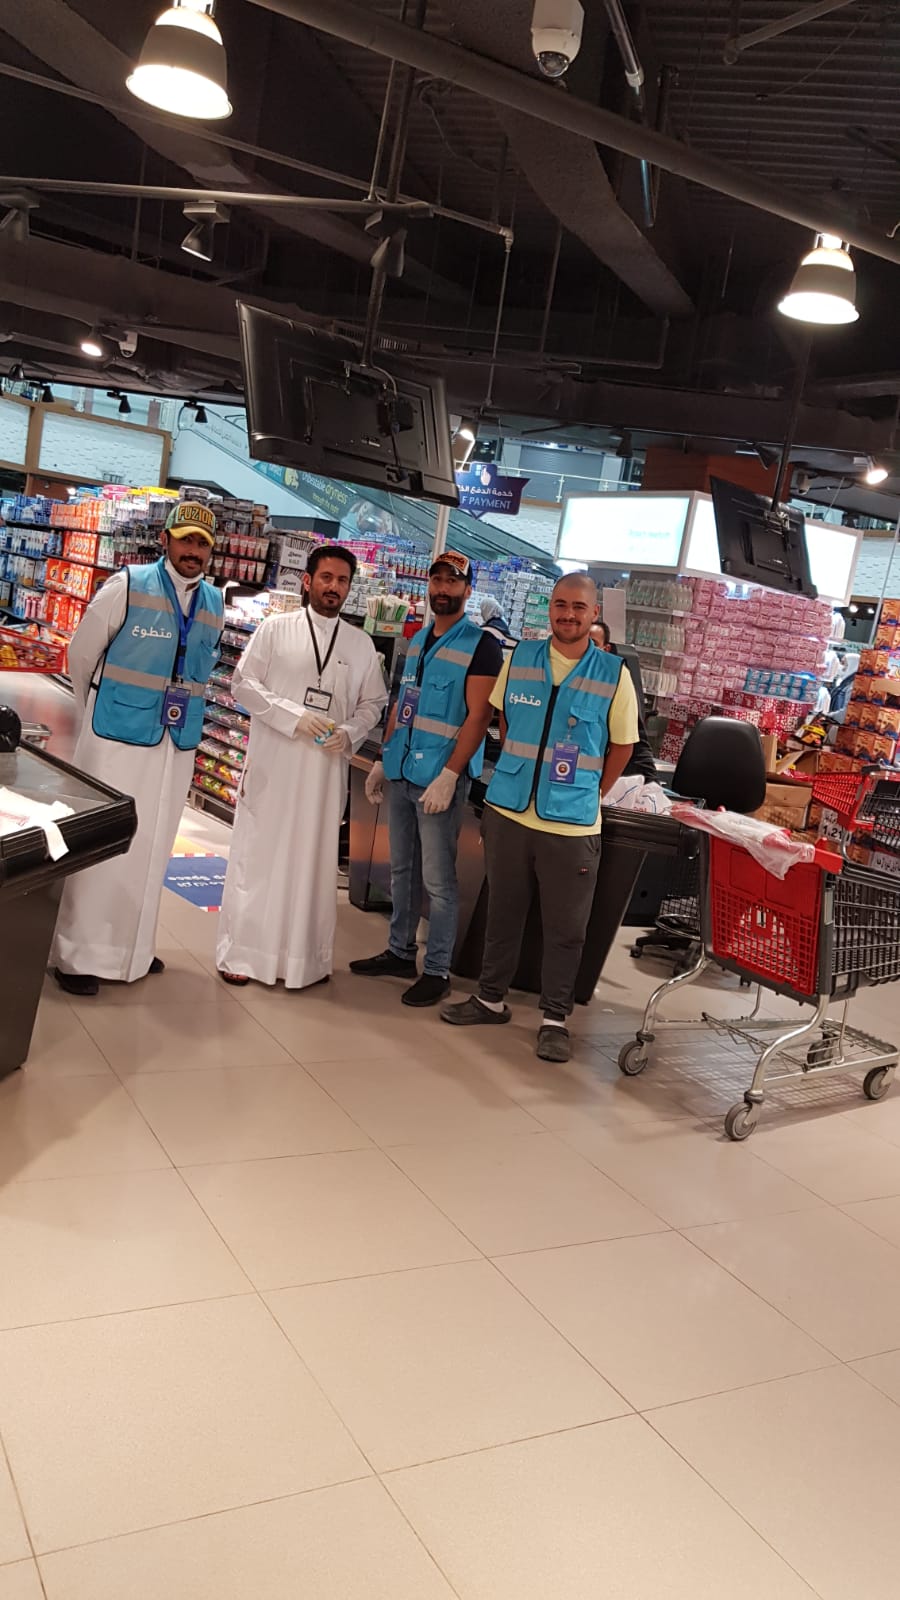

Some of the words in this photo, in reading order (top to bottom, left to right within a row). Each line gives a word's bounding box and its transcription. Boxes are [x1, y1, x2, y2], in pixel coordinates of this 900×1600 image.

[469, 497, 512, 510] PAYMENT
[131, 625, 172, 638] متطوع
[509, 692, 541, 706] متطوع
